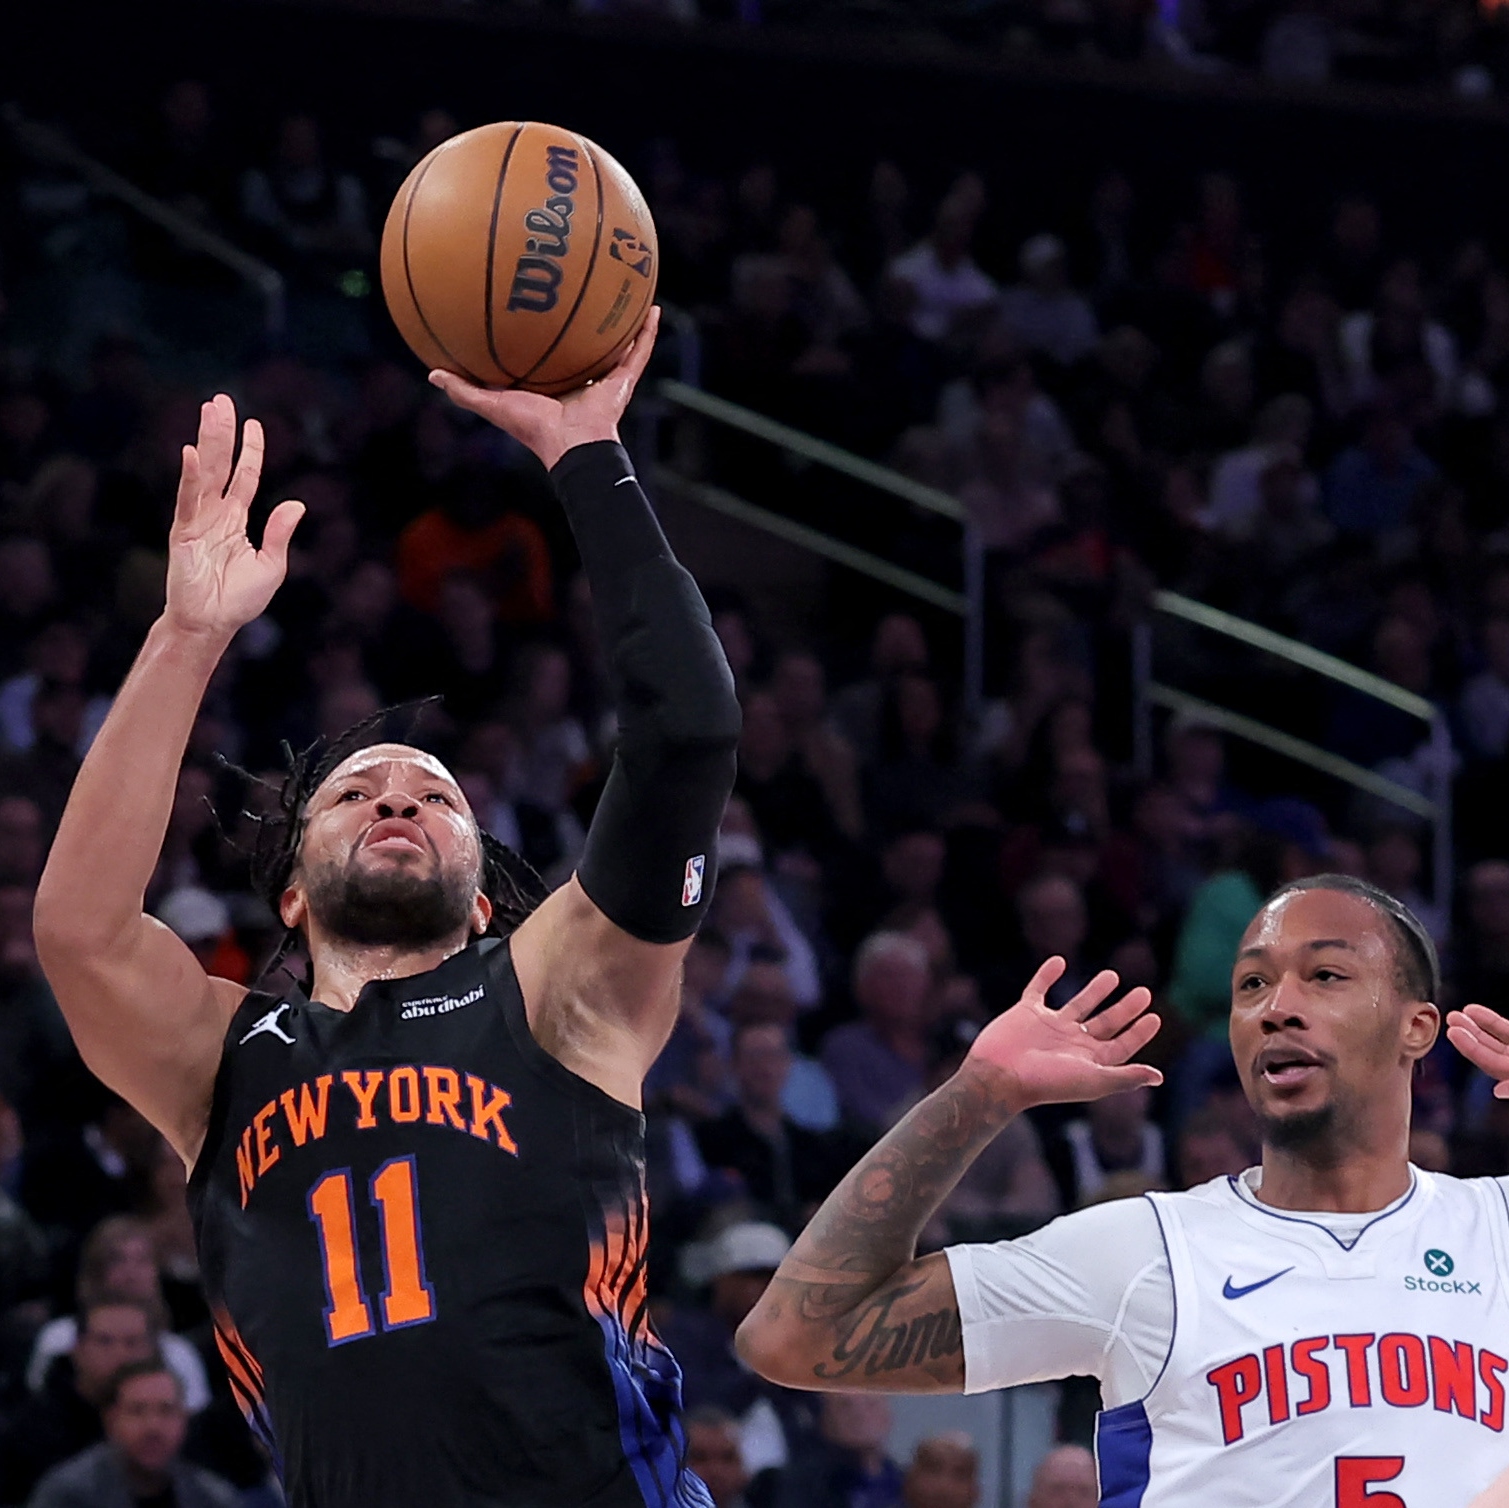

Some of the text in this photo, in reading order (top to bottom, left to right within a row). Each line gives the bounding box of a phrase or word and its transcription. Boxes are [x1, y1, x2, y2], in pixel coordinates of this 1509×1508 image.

[506, 145, 579, 313] Wilson
[401, 984, 485, 1020] abu dhabi
[235, 1065, 520, 1211] NEW YORK
[305, 1152, 438, 1349] 11
[1403, 1275, 1483, 1297] StockX
[1206, 1332, 1509, 1447] PISTONS
